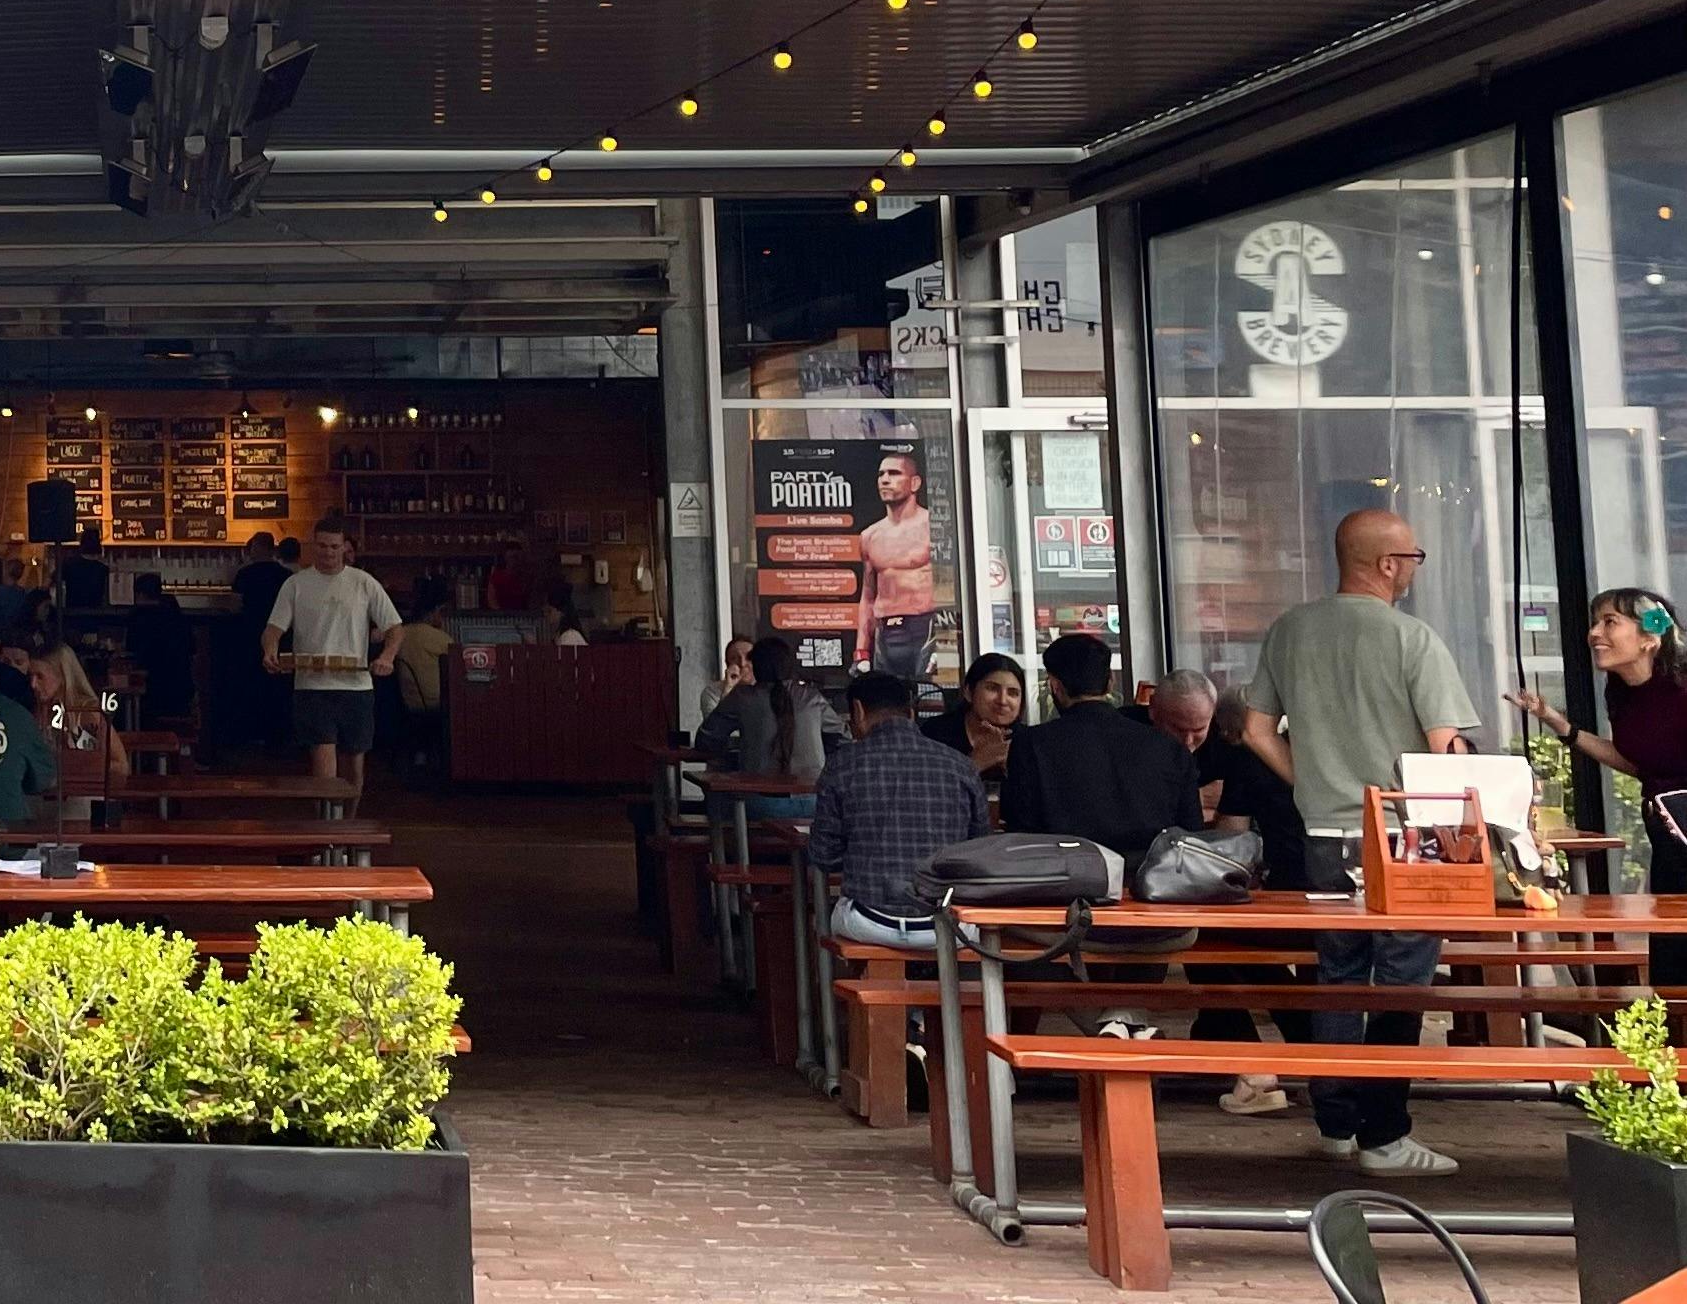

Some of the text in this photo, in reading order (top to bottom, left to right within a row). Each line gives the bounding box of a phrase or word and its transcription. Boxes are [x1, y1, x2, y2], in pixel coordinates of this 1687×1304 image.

[770, 471, 834, 482] PARTY
[787, 515, 808, 525] Live
[101, 691, 119, 712] 16
